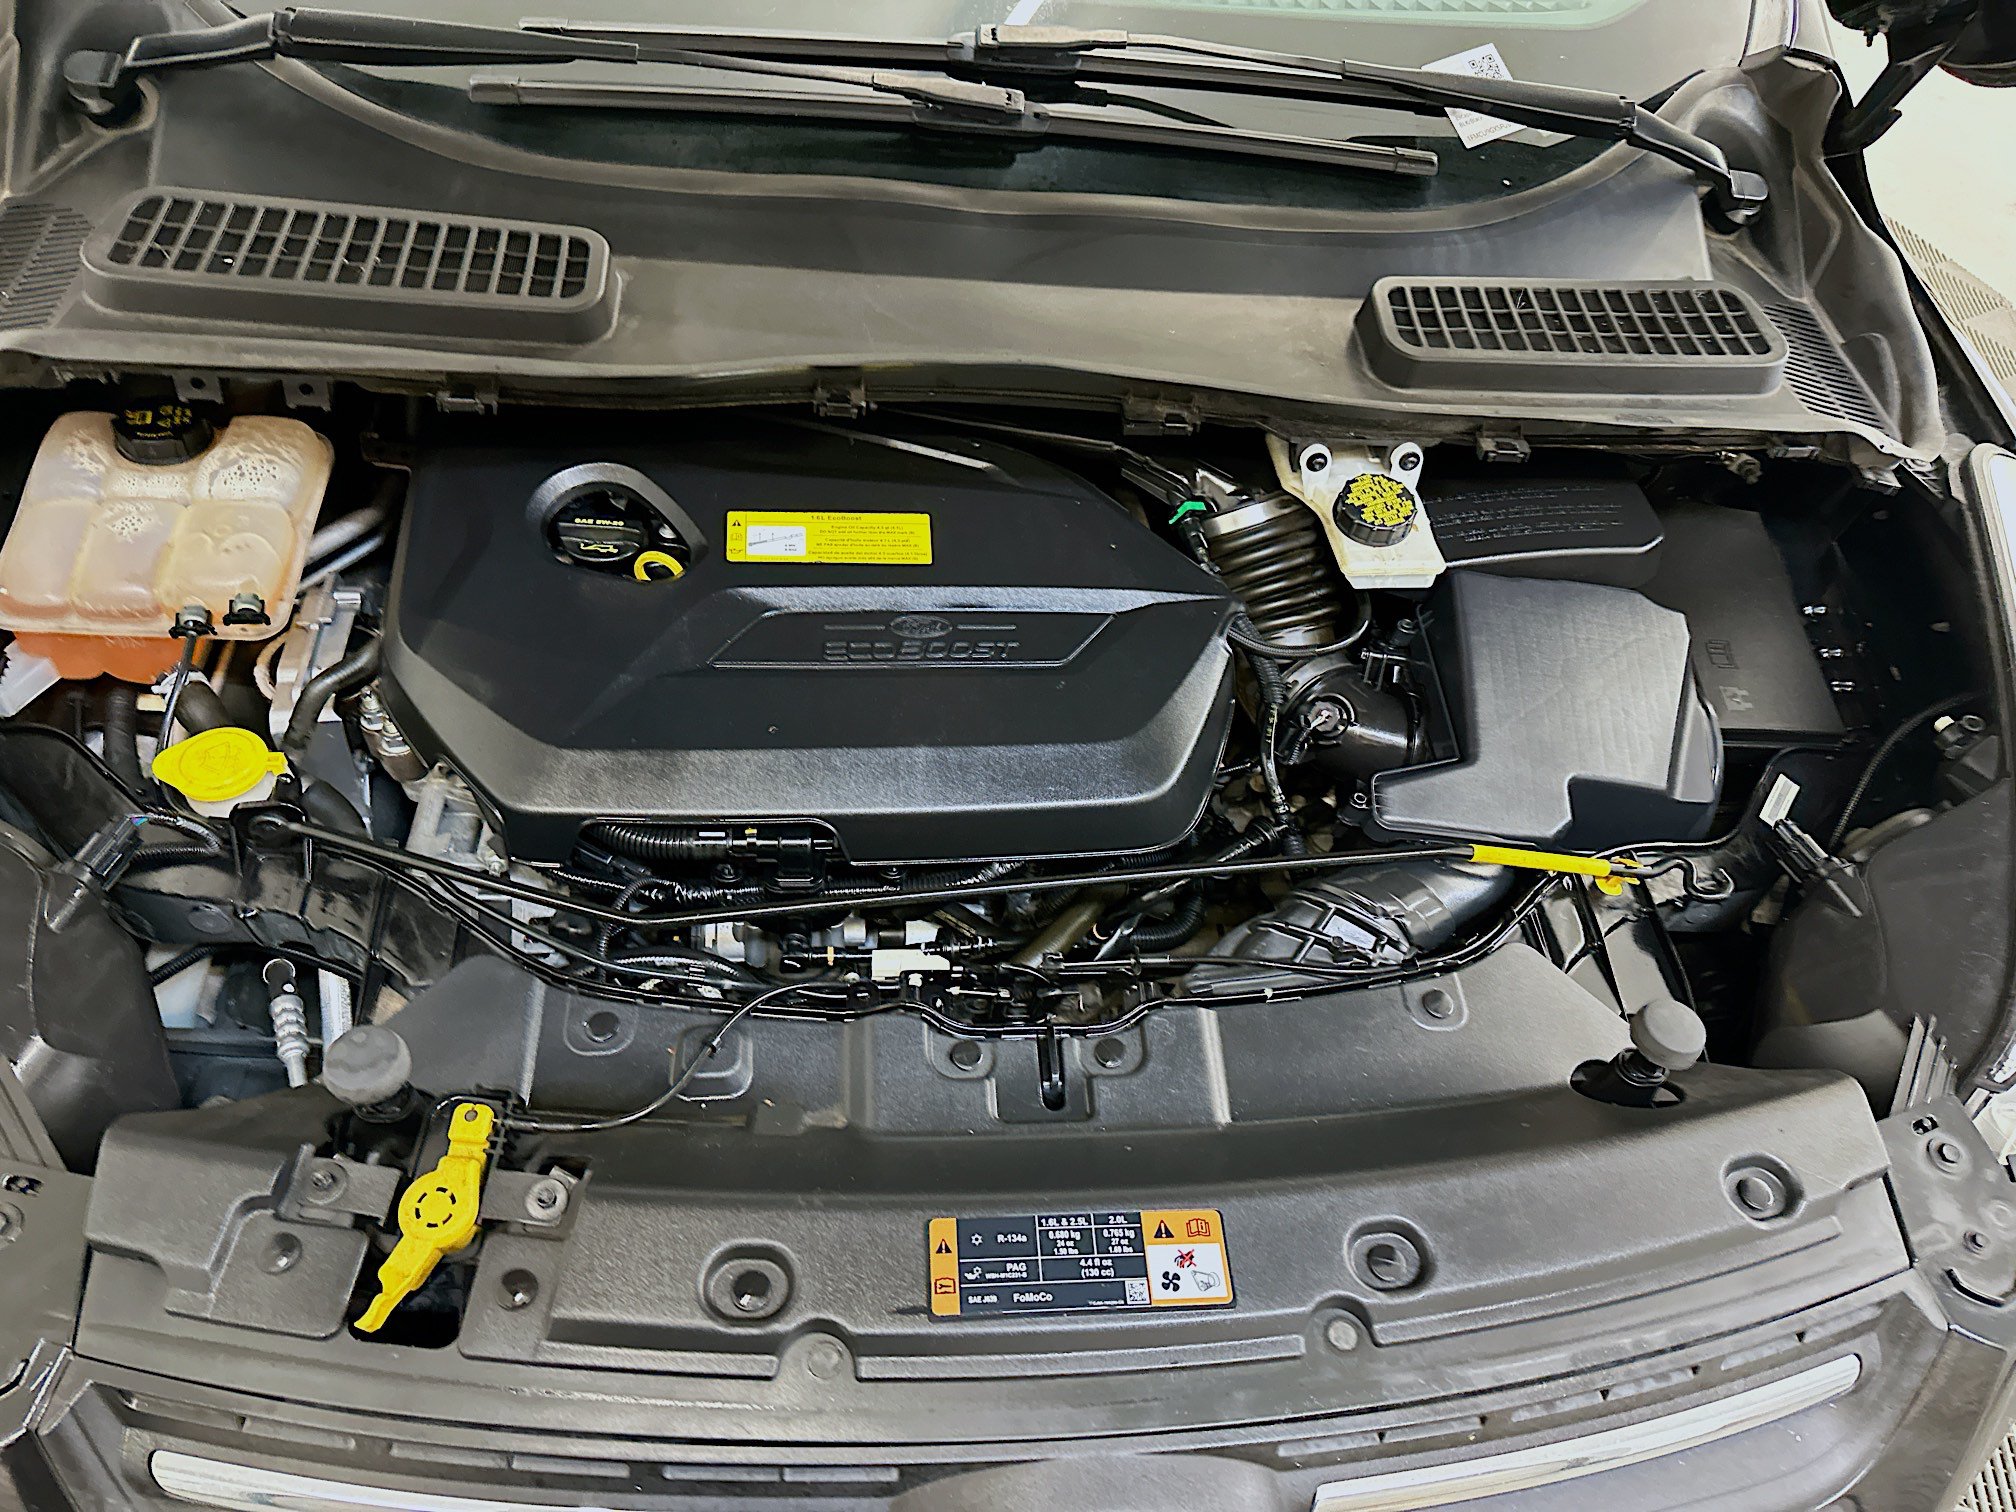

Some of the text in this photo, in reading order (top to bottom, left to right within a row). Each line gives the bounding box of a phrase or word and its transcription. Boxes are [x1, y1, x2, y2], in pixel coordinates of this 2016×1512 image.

[824, 641, 1020, 660] ECOBOOST
[1041, 1217, 1089, 1227] 1.6L & 2.5L
[1108, 1215, 1128, 1224] 2.0L
[996, 1234, 1028, 1243] R-134a
[1070, 1230, 1081, 1241] kg
[1102, 1228, 1136, 1239] 0.765 kg
[1111, 1238, 1119, 1246] 27
[1005, 1262, 1027, 1272] PAG
[1079, 1258, 1093, 1267] 4.4
[1102, 1259, 1113, 1267] oz
[1081, 1268, 1115, 1279] (130 cc)
[1013, 1292, 1054, 1303] FoMoCo
